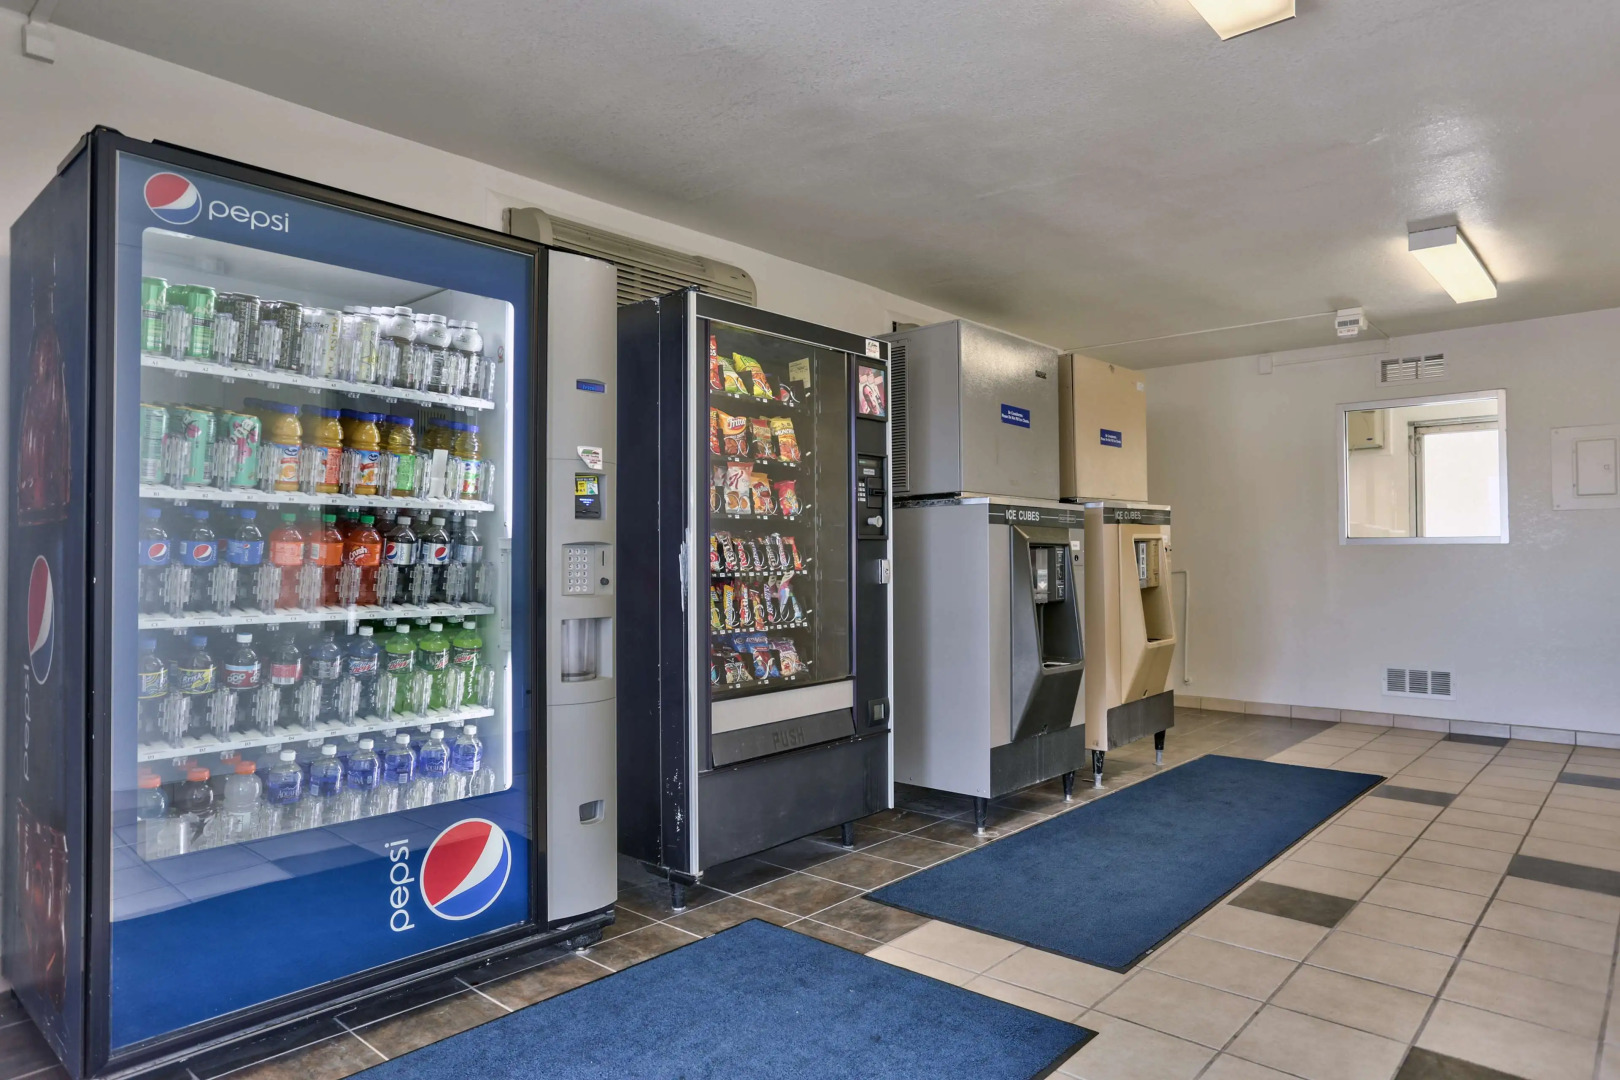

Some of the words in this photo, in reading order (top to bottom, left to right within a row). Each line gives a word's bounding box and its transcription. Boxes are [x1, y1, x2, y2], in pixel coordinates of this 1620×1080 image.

[208, 198, 290, 233] pepsi
[1005, 510, 1017, 520] ICE
[1018, 510, 1040, 522] CUBES
[1114, 511, 1123, 520] ICE
[1124, 511, 1141, 520] CUBES
[348, 547, 368, 560] Crush
[23, 664, 32, 782] pepsi
[772, 727, 805, 749] PUSH
[384, 838, 415, 932] pepsi
